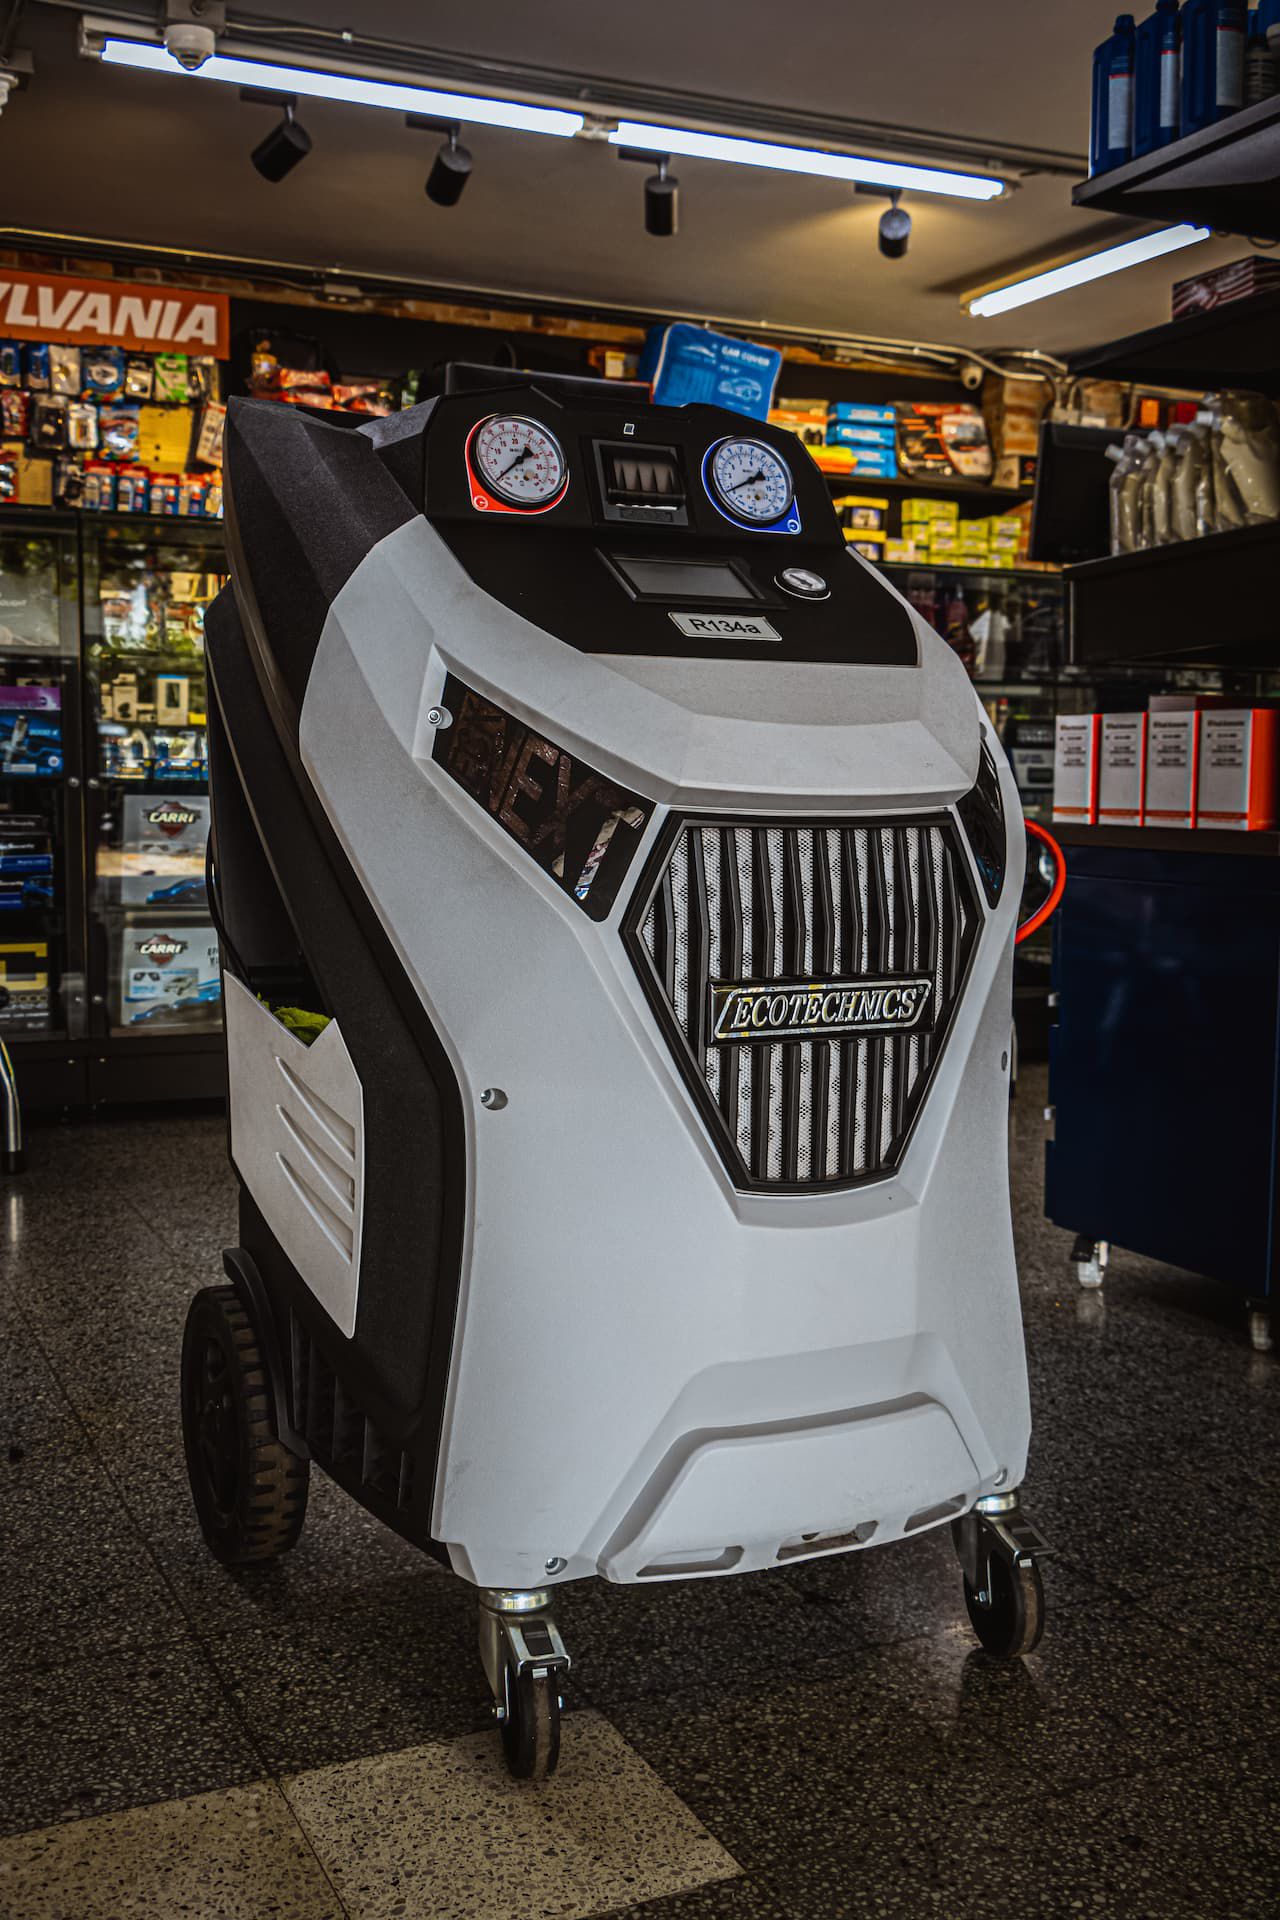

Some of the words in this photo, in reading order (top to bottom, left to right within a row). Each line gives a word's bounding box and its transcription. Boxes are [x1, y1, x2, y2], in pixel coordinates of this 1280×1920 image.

[688, 618, 762, 634] R134a
[149, 811, 195, 823] CARRI
[140, 943, 182, 954] CARRI
[731, 987, 917, 1029] ECOTECHNICS
